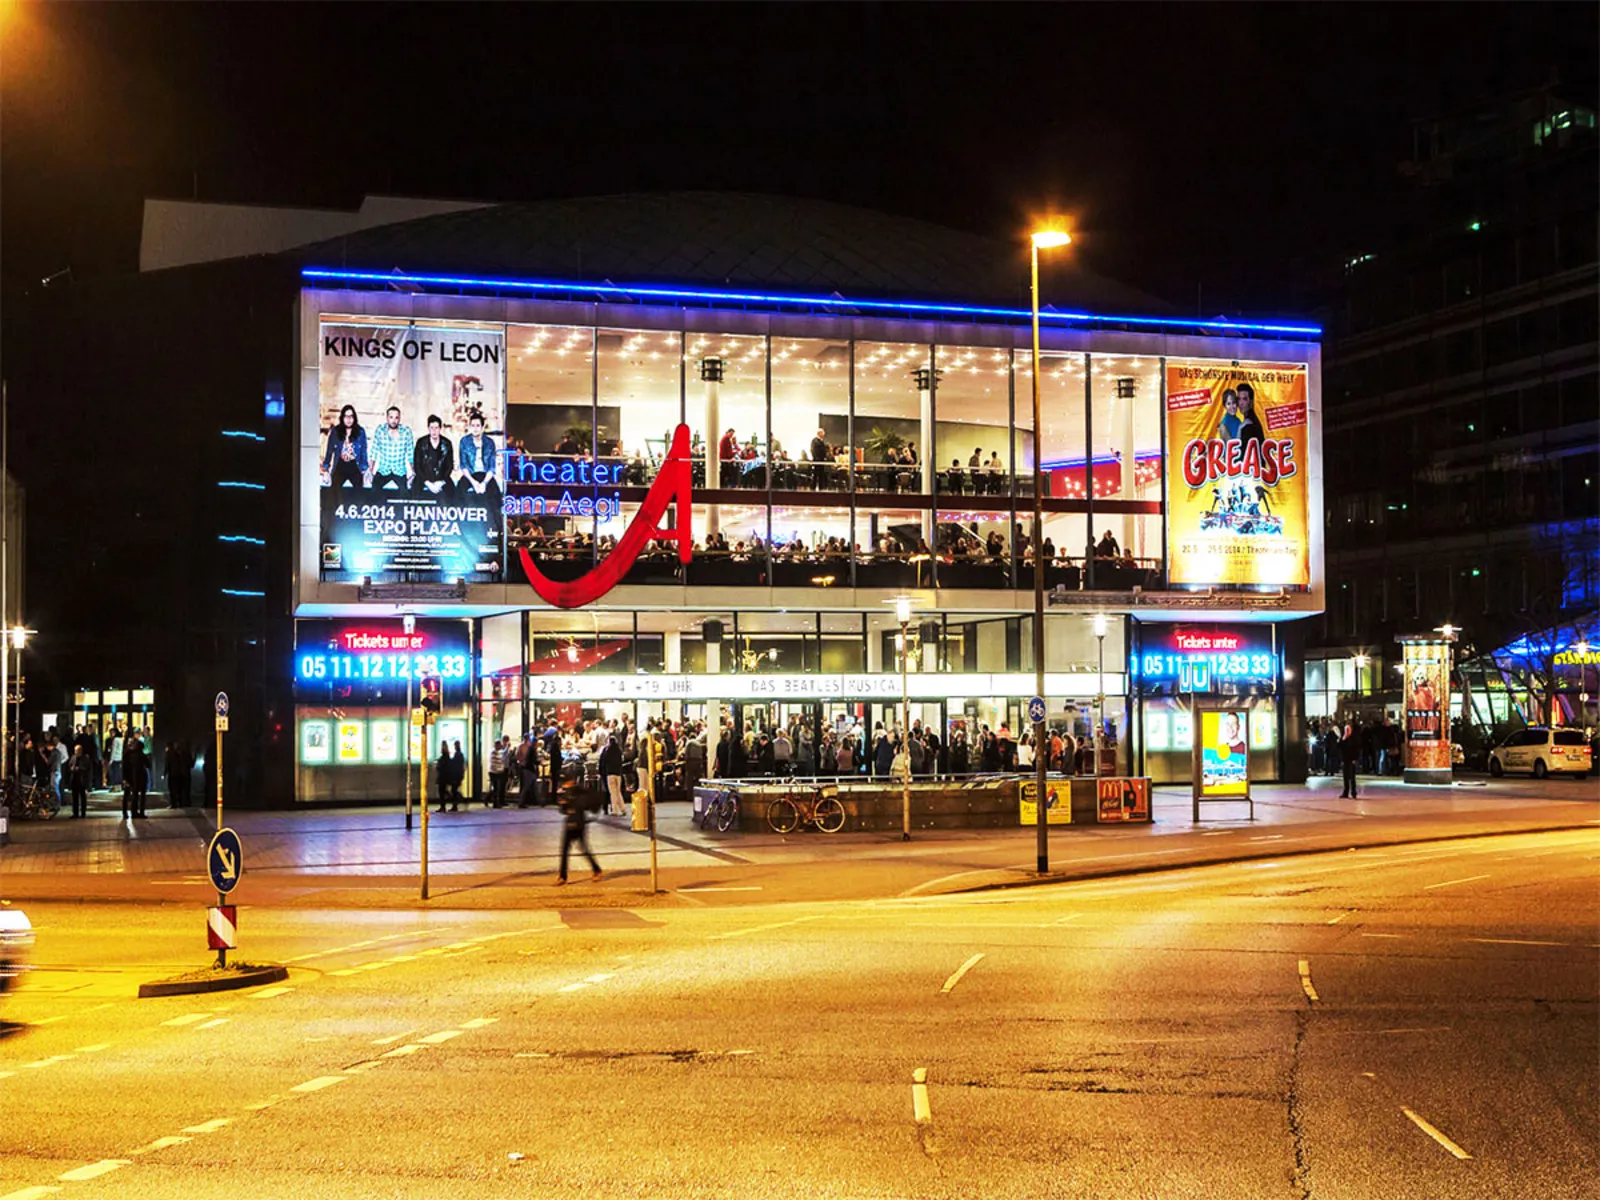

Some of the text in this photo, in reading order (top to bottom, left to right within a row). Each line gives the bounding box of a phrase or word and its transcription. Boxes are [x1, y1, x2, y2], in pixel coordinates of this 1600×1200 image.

[324, 336, 499, 364] KINGS OF LEON
[1261, 373, 1275, 383] DER
[1277, 373, 1294, 384] WELT
[496, 448, 624, 484] Theater
[1183, 438, 1296, 488] GREASE
[335, 504, 488, 521] 4.6.2014 HANNOVER
[501, 490, 620, 524] am Aegi
[363, 520, 461, 535] EXPO PLAZA
[345, 633, 424, 648] Tickets uner
[1176, 635, 1238, 649] Tickets unter
[302, 655, 326, 678] 05
[388, 655, 409, 678] 12
[441, 655, 466, 678] 33
[1251, 655, 1270, 675] 33
[540, 680, 581, 694] 23.3.
[751, 679, 776, 692] DAS
[784, 680, 840, 693] BEATLES
